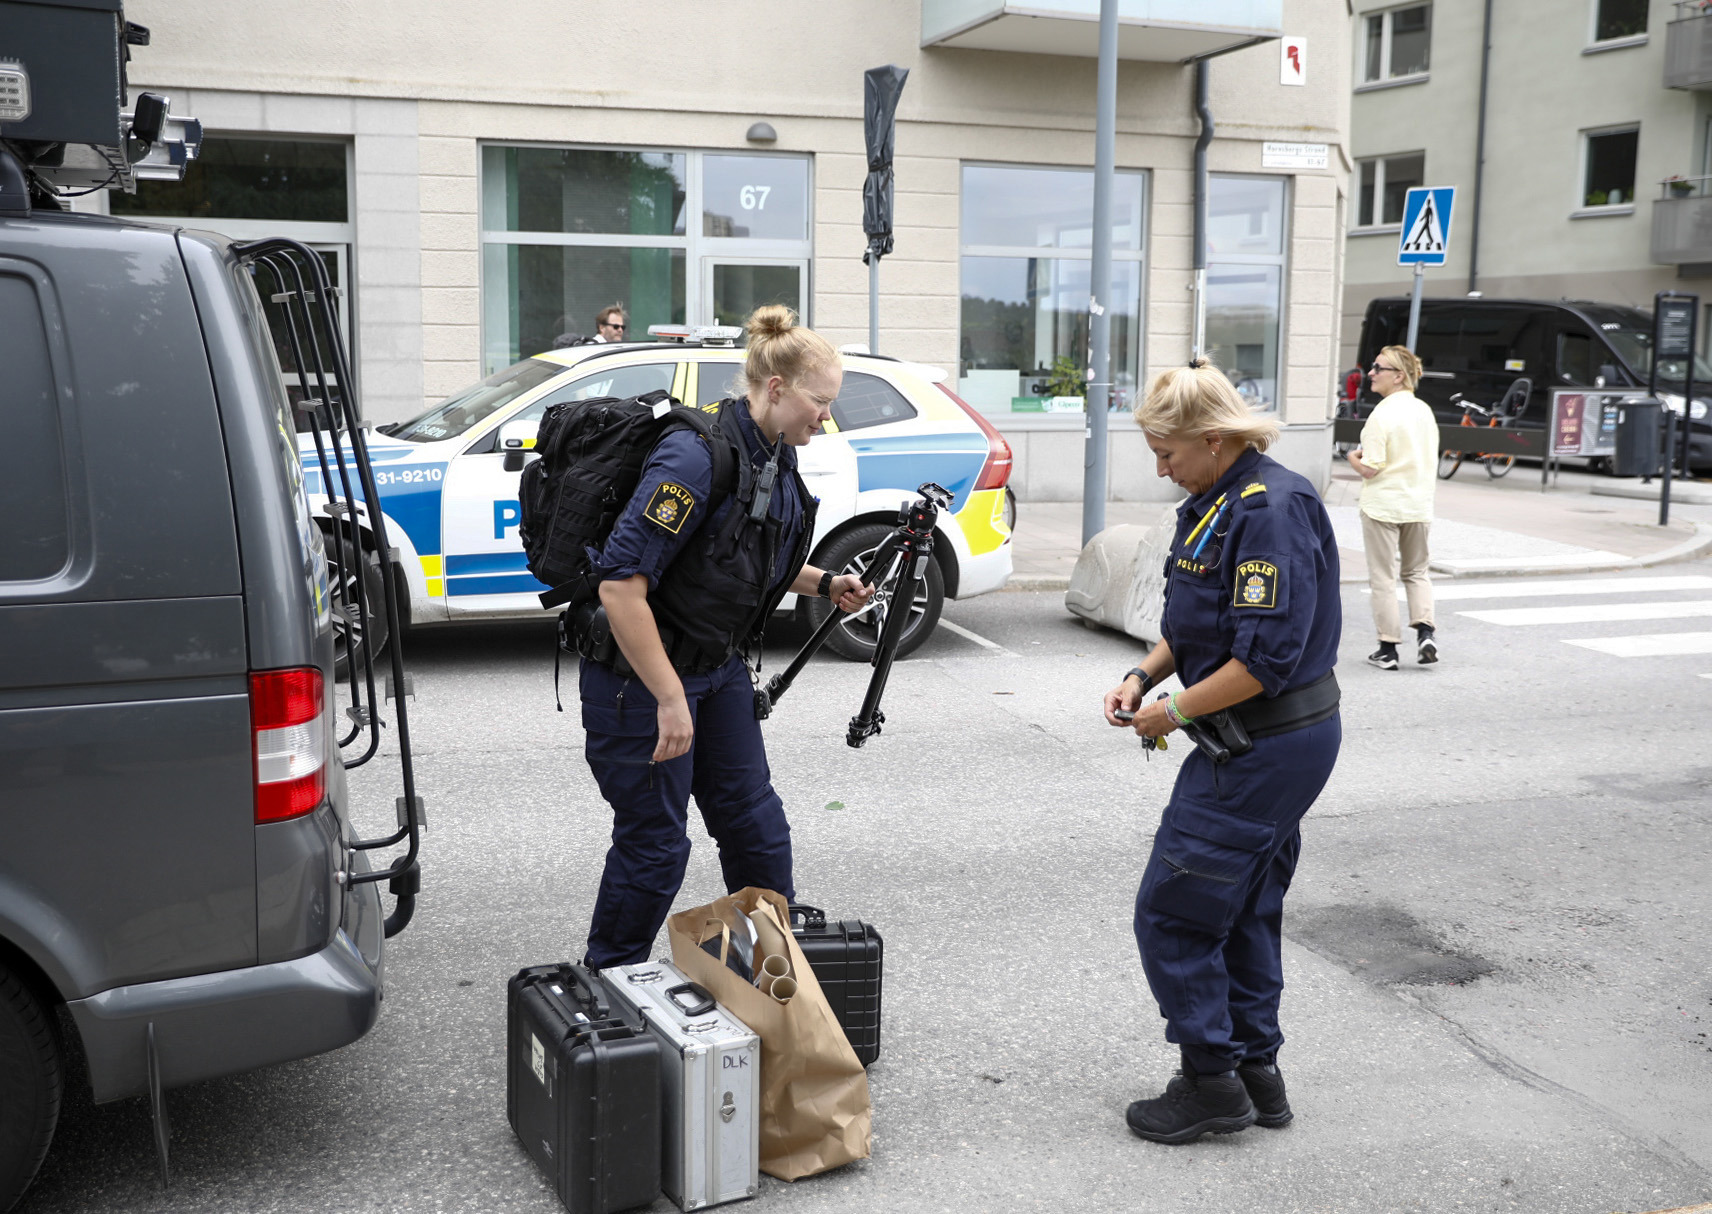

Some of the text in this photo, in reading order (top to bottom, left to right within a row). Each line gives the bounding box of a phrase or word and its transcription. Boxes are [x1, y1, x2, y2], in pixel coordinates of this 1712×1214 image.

[740, 185, 770, 210] 67
[376, 468, 442, 485] 31-9210
[662, 485, 692, 505] POLIS
[1177, 559, 1206, 573] POLIS
[1240, 563, 1274, 577] POLIS
[723, 1055, 748, 1069] DLK
